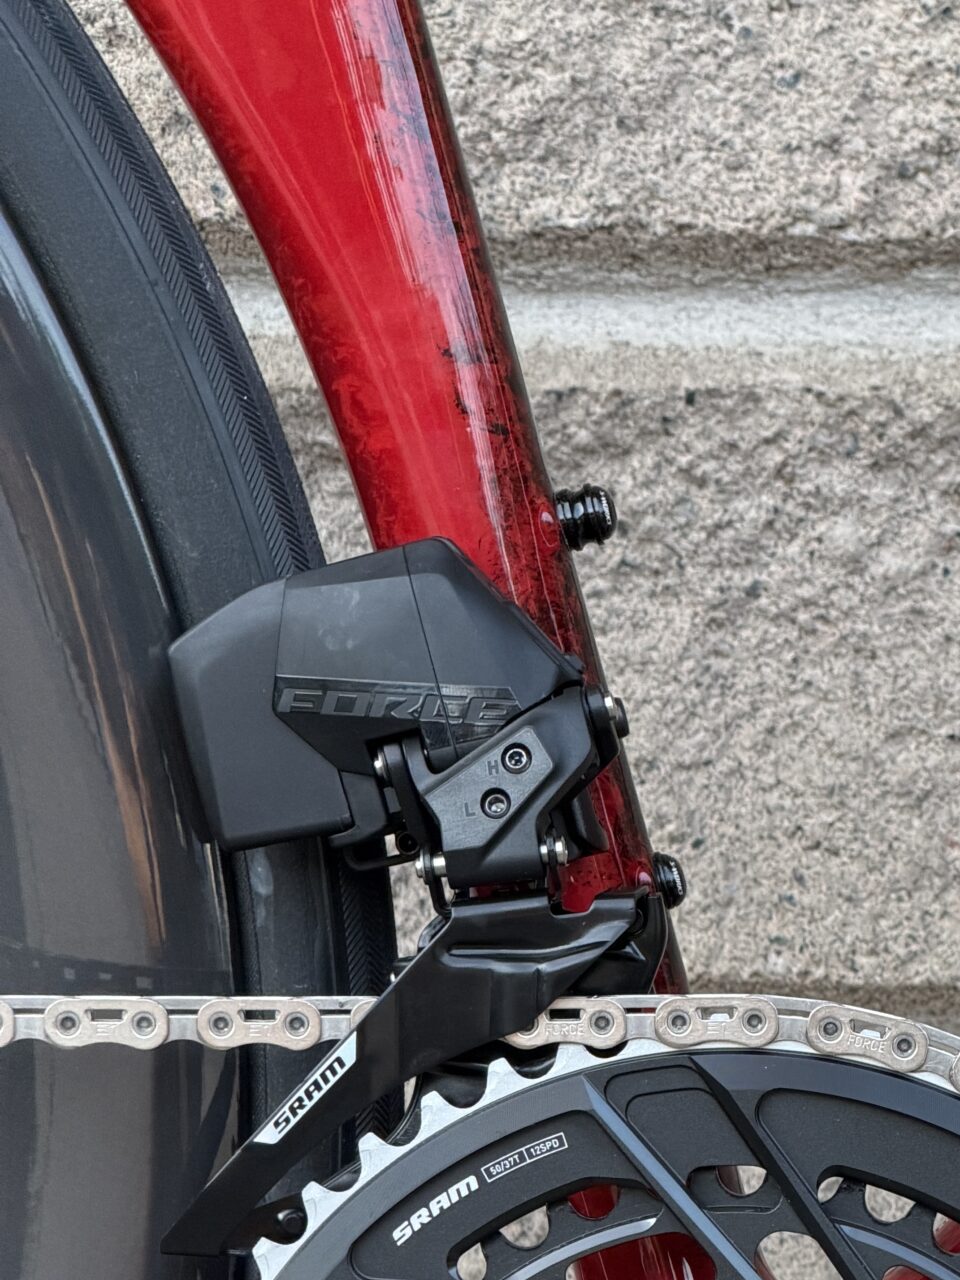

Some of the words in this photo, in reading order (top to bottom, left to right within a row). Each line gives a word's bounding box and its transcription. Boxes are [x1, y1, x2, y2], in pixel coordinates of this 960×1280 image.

[276, 688, 519, 725] FORCE
[487, 760, 499, 776] H
[464, 803, 476, 818] L
[545, 1024, 585, 1035] FORCE
[847, 1034, 887, 1053] FORCE
[272, 1056, 347, 1135] SRAM
[489, 1154, 520, 1175] 50/37T
[530, 1138, 560, 1157] 12SPD
[392, 1175, 479, 1246] SRAM
